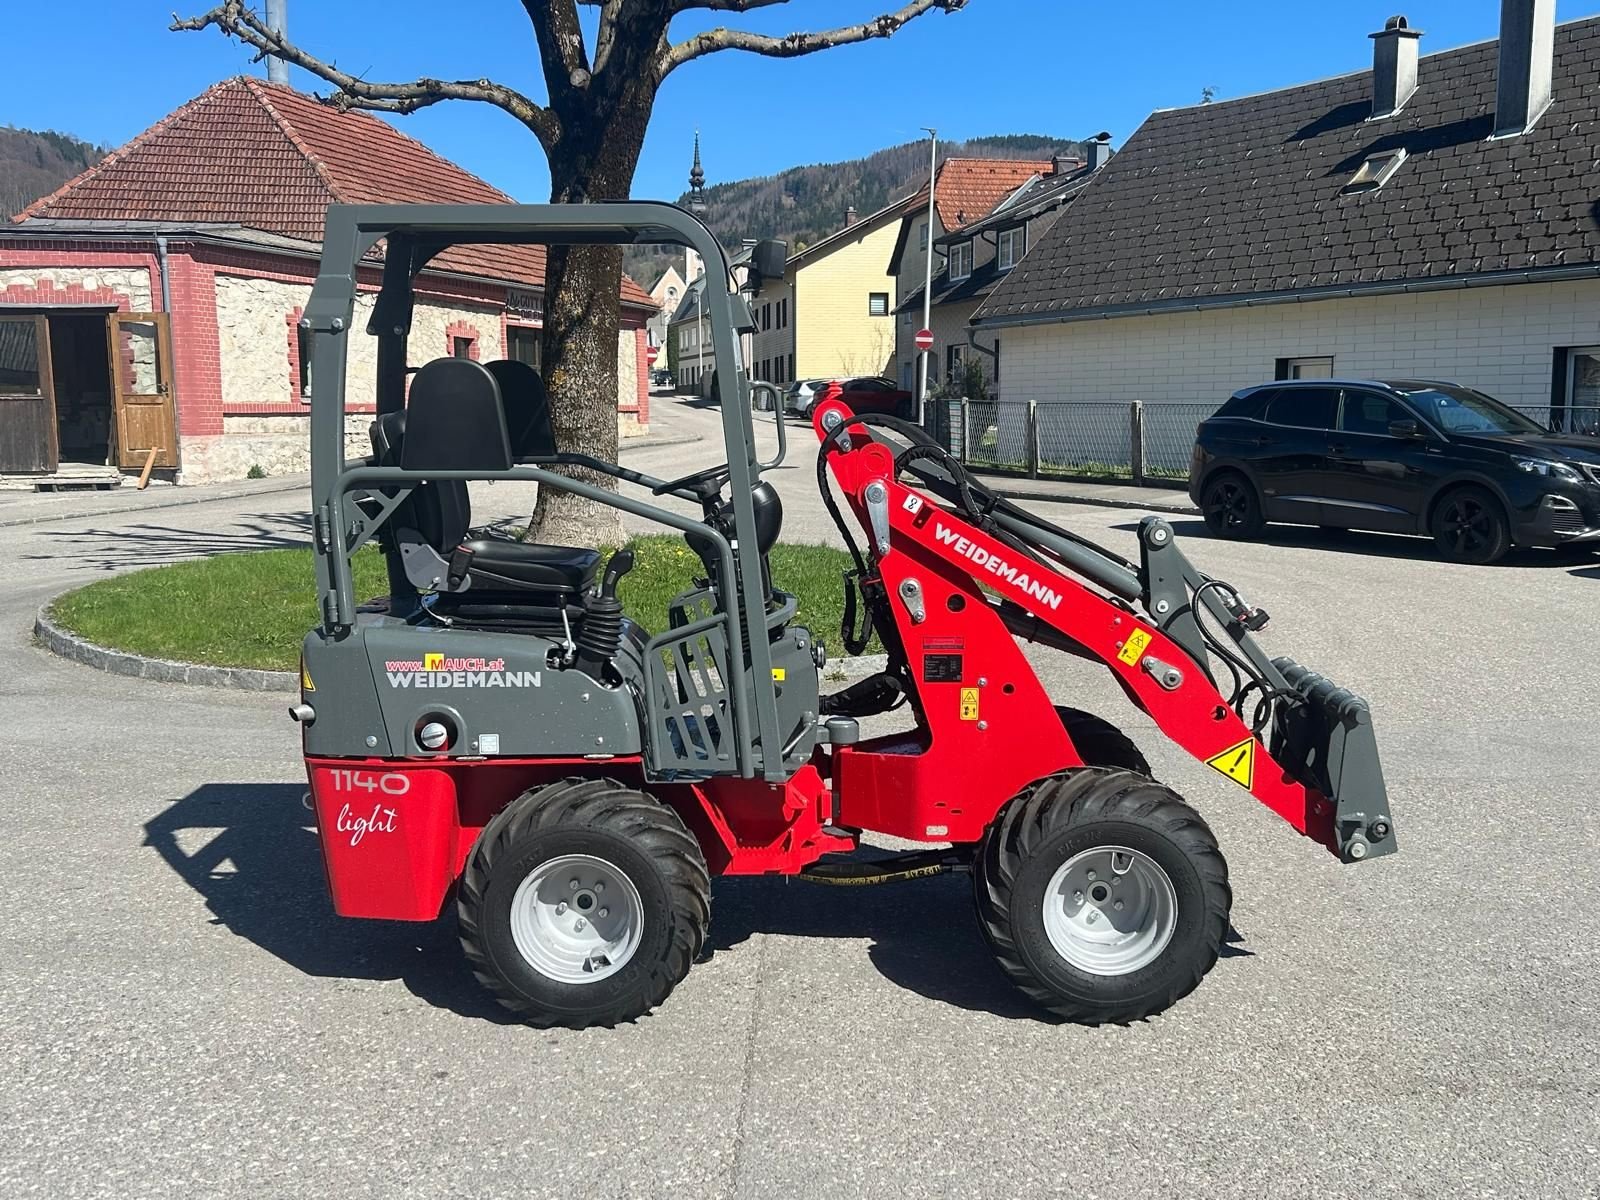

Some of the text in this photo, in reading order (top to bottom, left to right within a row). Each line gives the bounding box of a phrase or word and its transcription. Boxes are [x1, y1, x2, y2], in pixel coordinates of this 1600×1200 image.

[935, 522, 1063, 610] WEIDEMANN
[386, 671, 541, 688] WEIDEMANN
[330, 769, 410, 795] 1140
[336, 803, 398, 846] light
